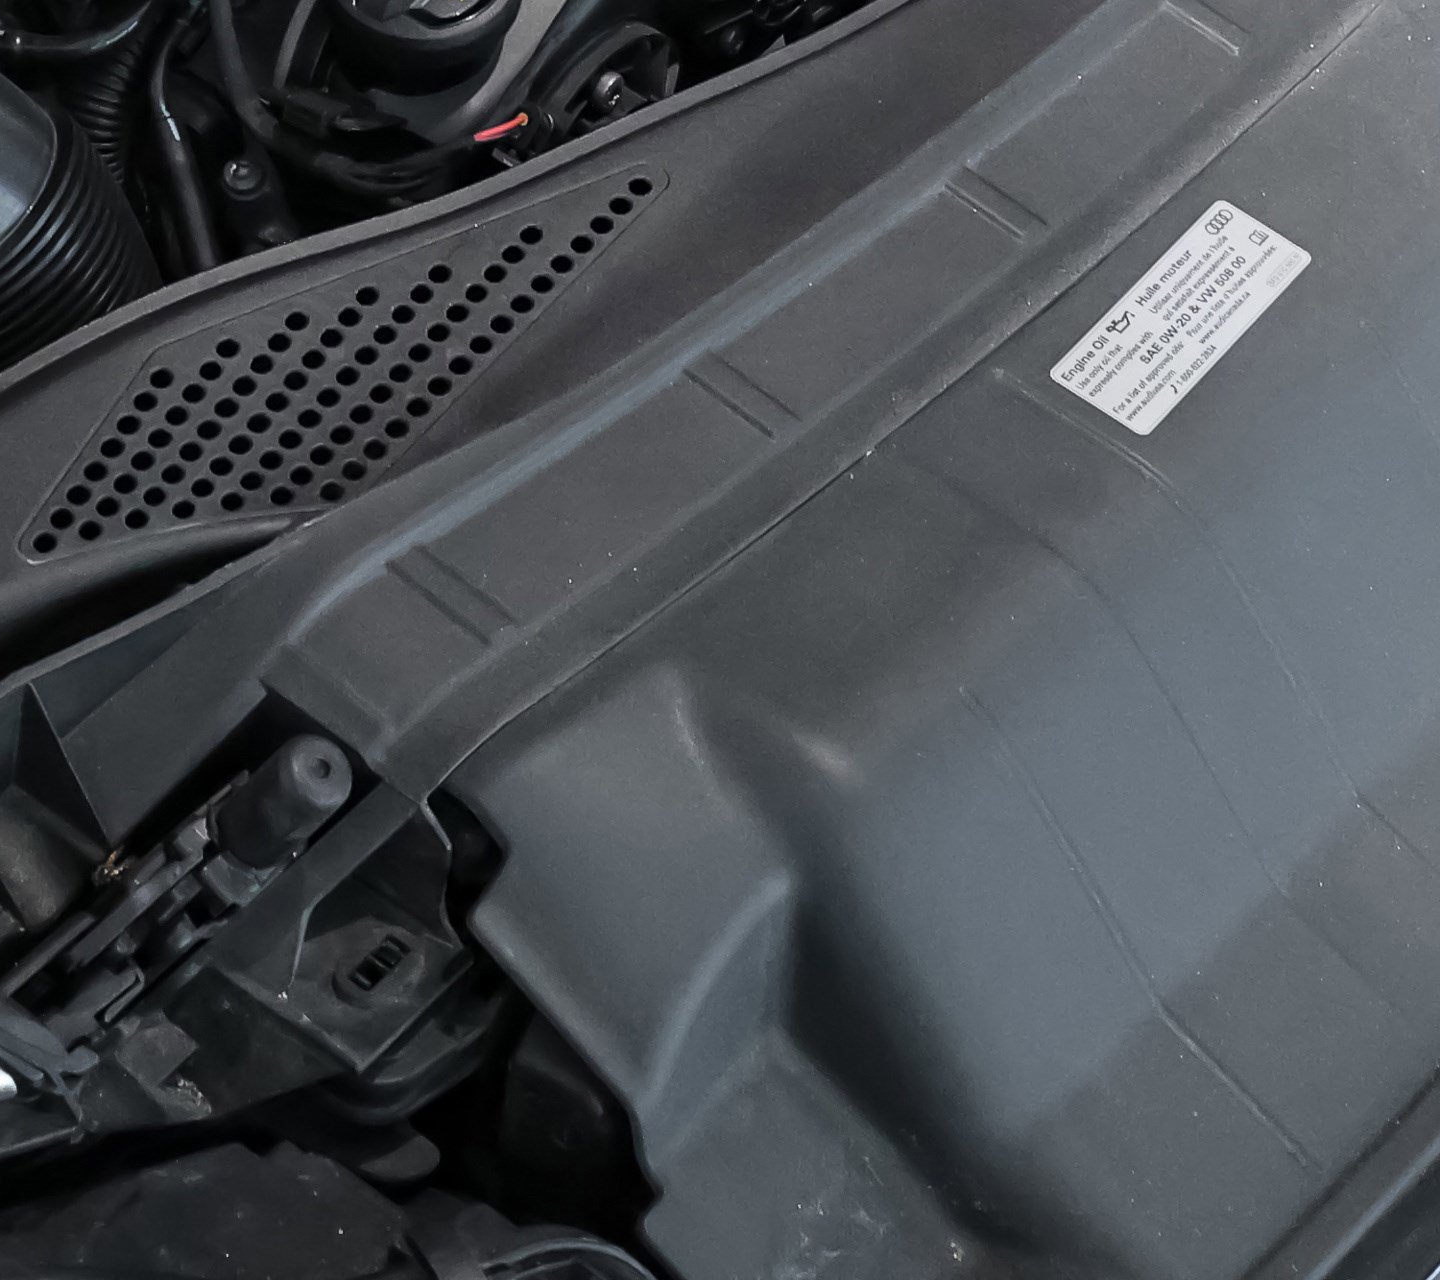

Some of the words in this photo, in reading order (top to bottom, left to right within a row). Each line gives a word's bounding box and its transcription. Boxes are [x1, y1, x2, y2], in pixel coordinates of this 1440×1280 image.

[1134, 283, 1161, 306] Huile
[1159, 249, 1191, 283] moteur
[1139, 342, 1163, 364] SAE
[1158, 312, 1191, 343] 0W-20
[1187, 304, 1201, 313] &
[1195, 284, 1216, 302] VW
[1213, 267, 1234, 287] 508
[1230, 255, 1246, 269] 00
[1060, 350, 1095, 382] Engine
[1091, 334, 1109, 349] Oil
